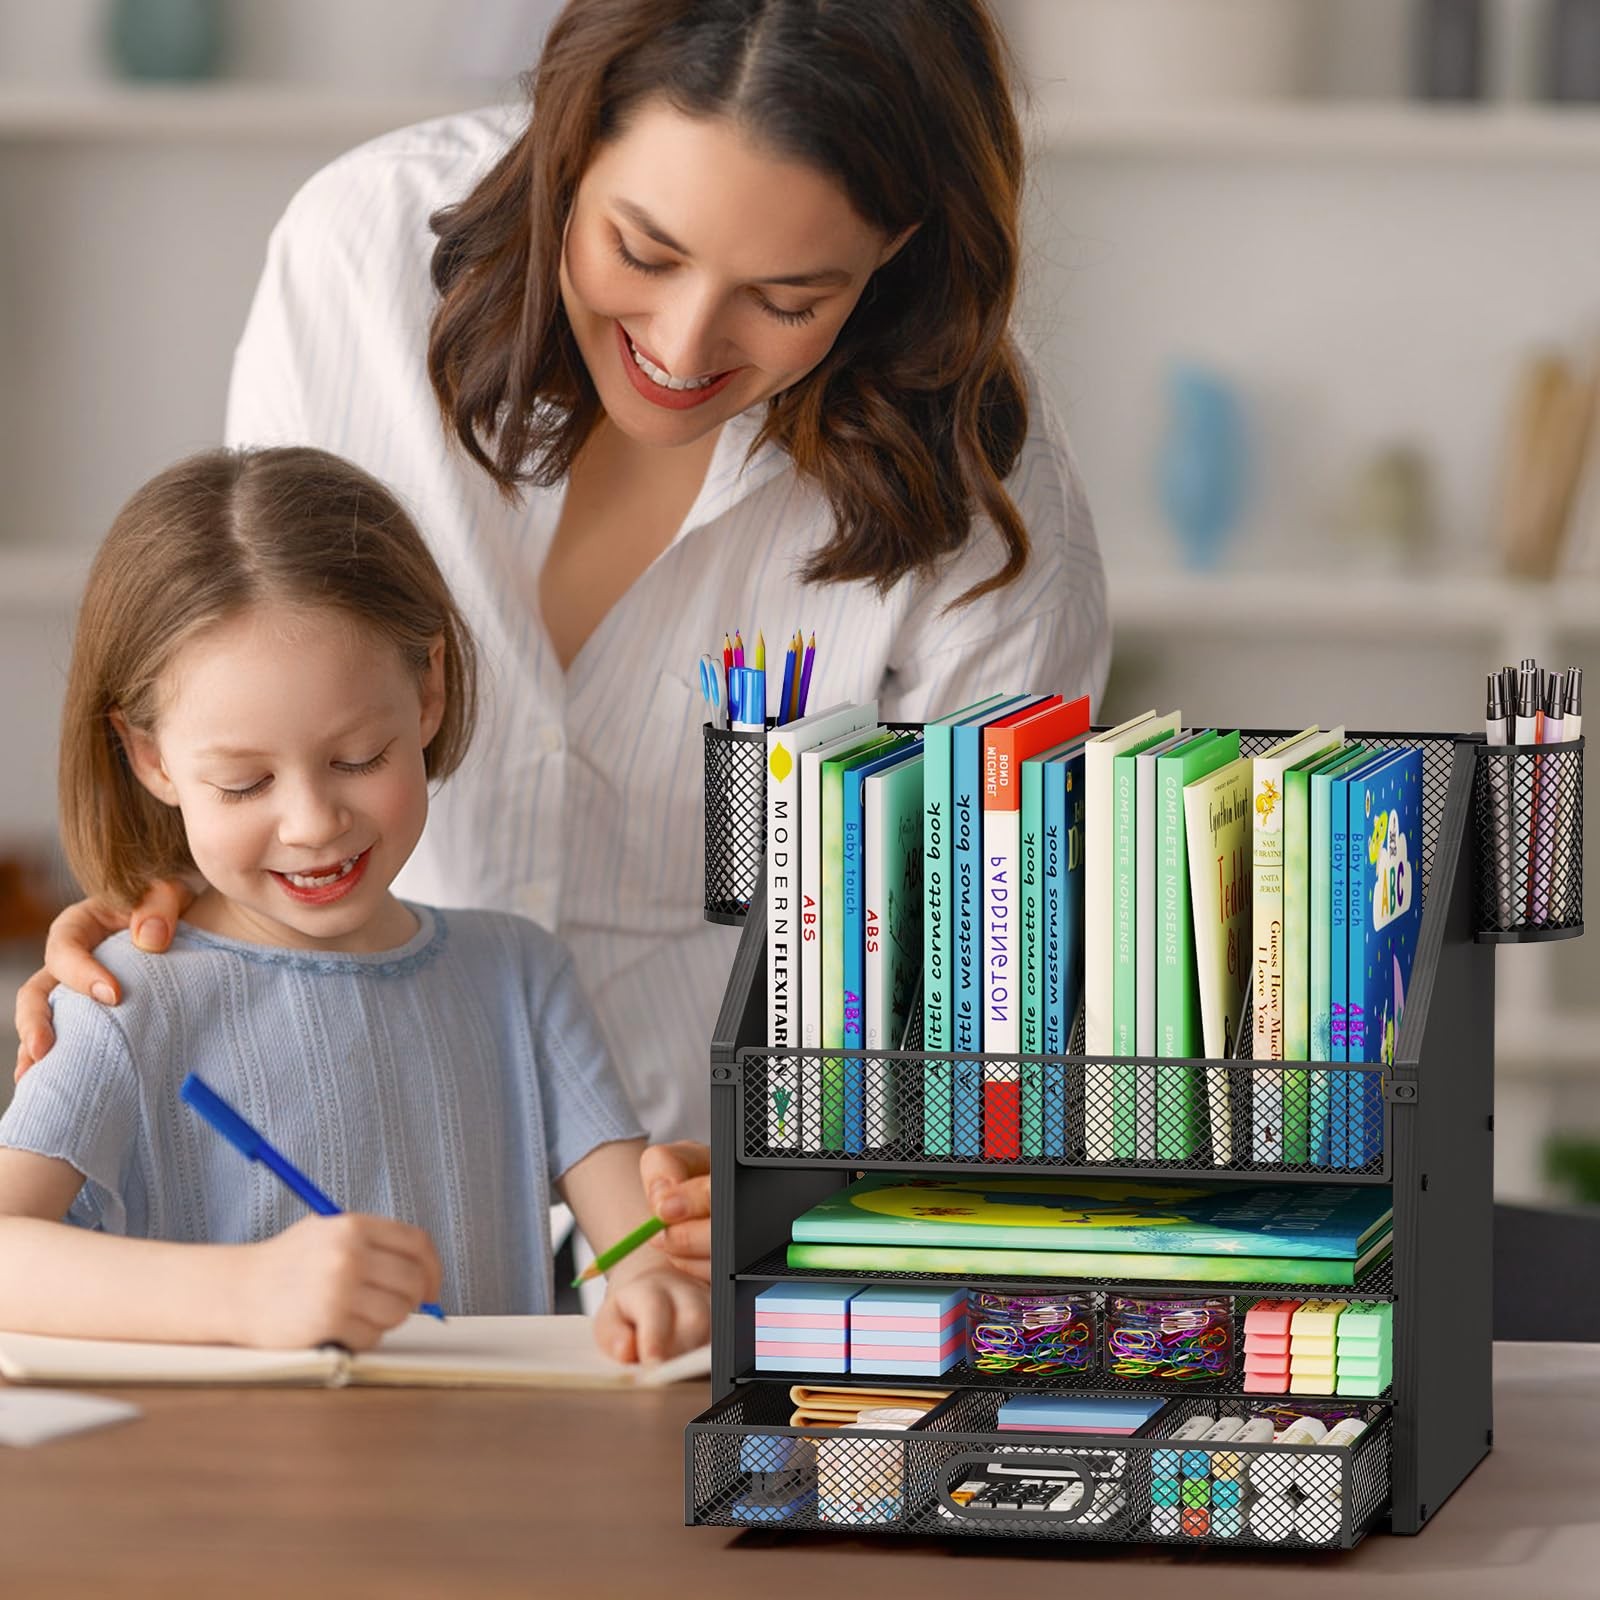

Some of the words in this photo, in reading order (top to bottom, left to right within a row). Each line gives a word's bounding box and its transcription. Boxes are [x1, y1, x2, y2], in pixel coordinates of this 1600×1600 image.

[845, 823, 858, 861] Baby
[926, 802, 941, 860] book
[956, 794, 971, 851] book
[1119, 775, 1129, 865] COMPLETE
[1165, 776, 1177, 866] COMPLETE
[774, 801, 788, 934] MODERN
[1023, 832, 1035, 886] book
[1046, 825, 1058, 878] book
[1332, 833, 1346, 872] Baby
[1350, 833, 1364, 873] Baby
[847, 868, 858, 915] touch
[1334, 879, 1346, 926] touch
[1352, 879, 1364, 927] touch
[1381, 861, 1405, 918] ABC
[803, 895, 817, 942] ABS
[866, 909, 880, 953] ABS
[928, 872, 942, 980] cornetto
[957, 863, 972, 989] westernos
[1119, 873, 1129, 964] NONSENSE
[1165, 875, 1177, 965] NONSENSE
[1025, 896, 1035, 996] cornetto
[1047, 888, 1058, 1005] westernos
[1270, 920, 1281, 968] Guess
[1257, 957, 1268, 997] Love
[1270, 974, 1281, 1012] How
[844, 990, 861, 1035] ABC
[927, 991, 942, 1049] little
[957, 1000, 972, 1052] ittle
[1024, 1007, 1036, 1054] ittle
[1257, 1003, 1268, 1034] You
[1331, 1002, 1348, 1047] ABC
[1349, 1002, 1365, 1048] ABC
[1046, 1015, 1059, 1067] ttle
[1270, 1017, 1281, 1061] Much
